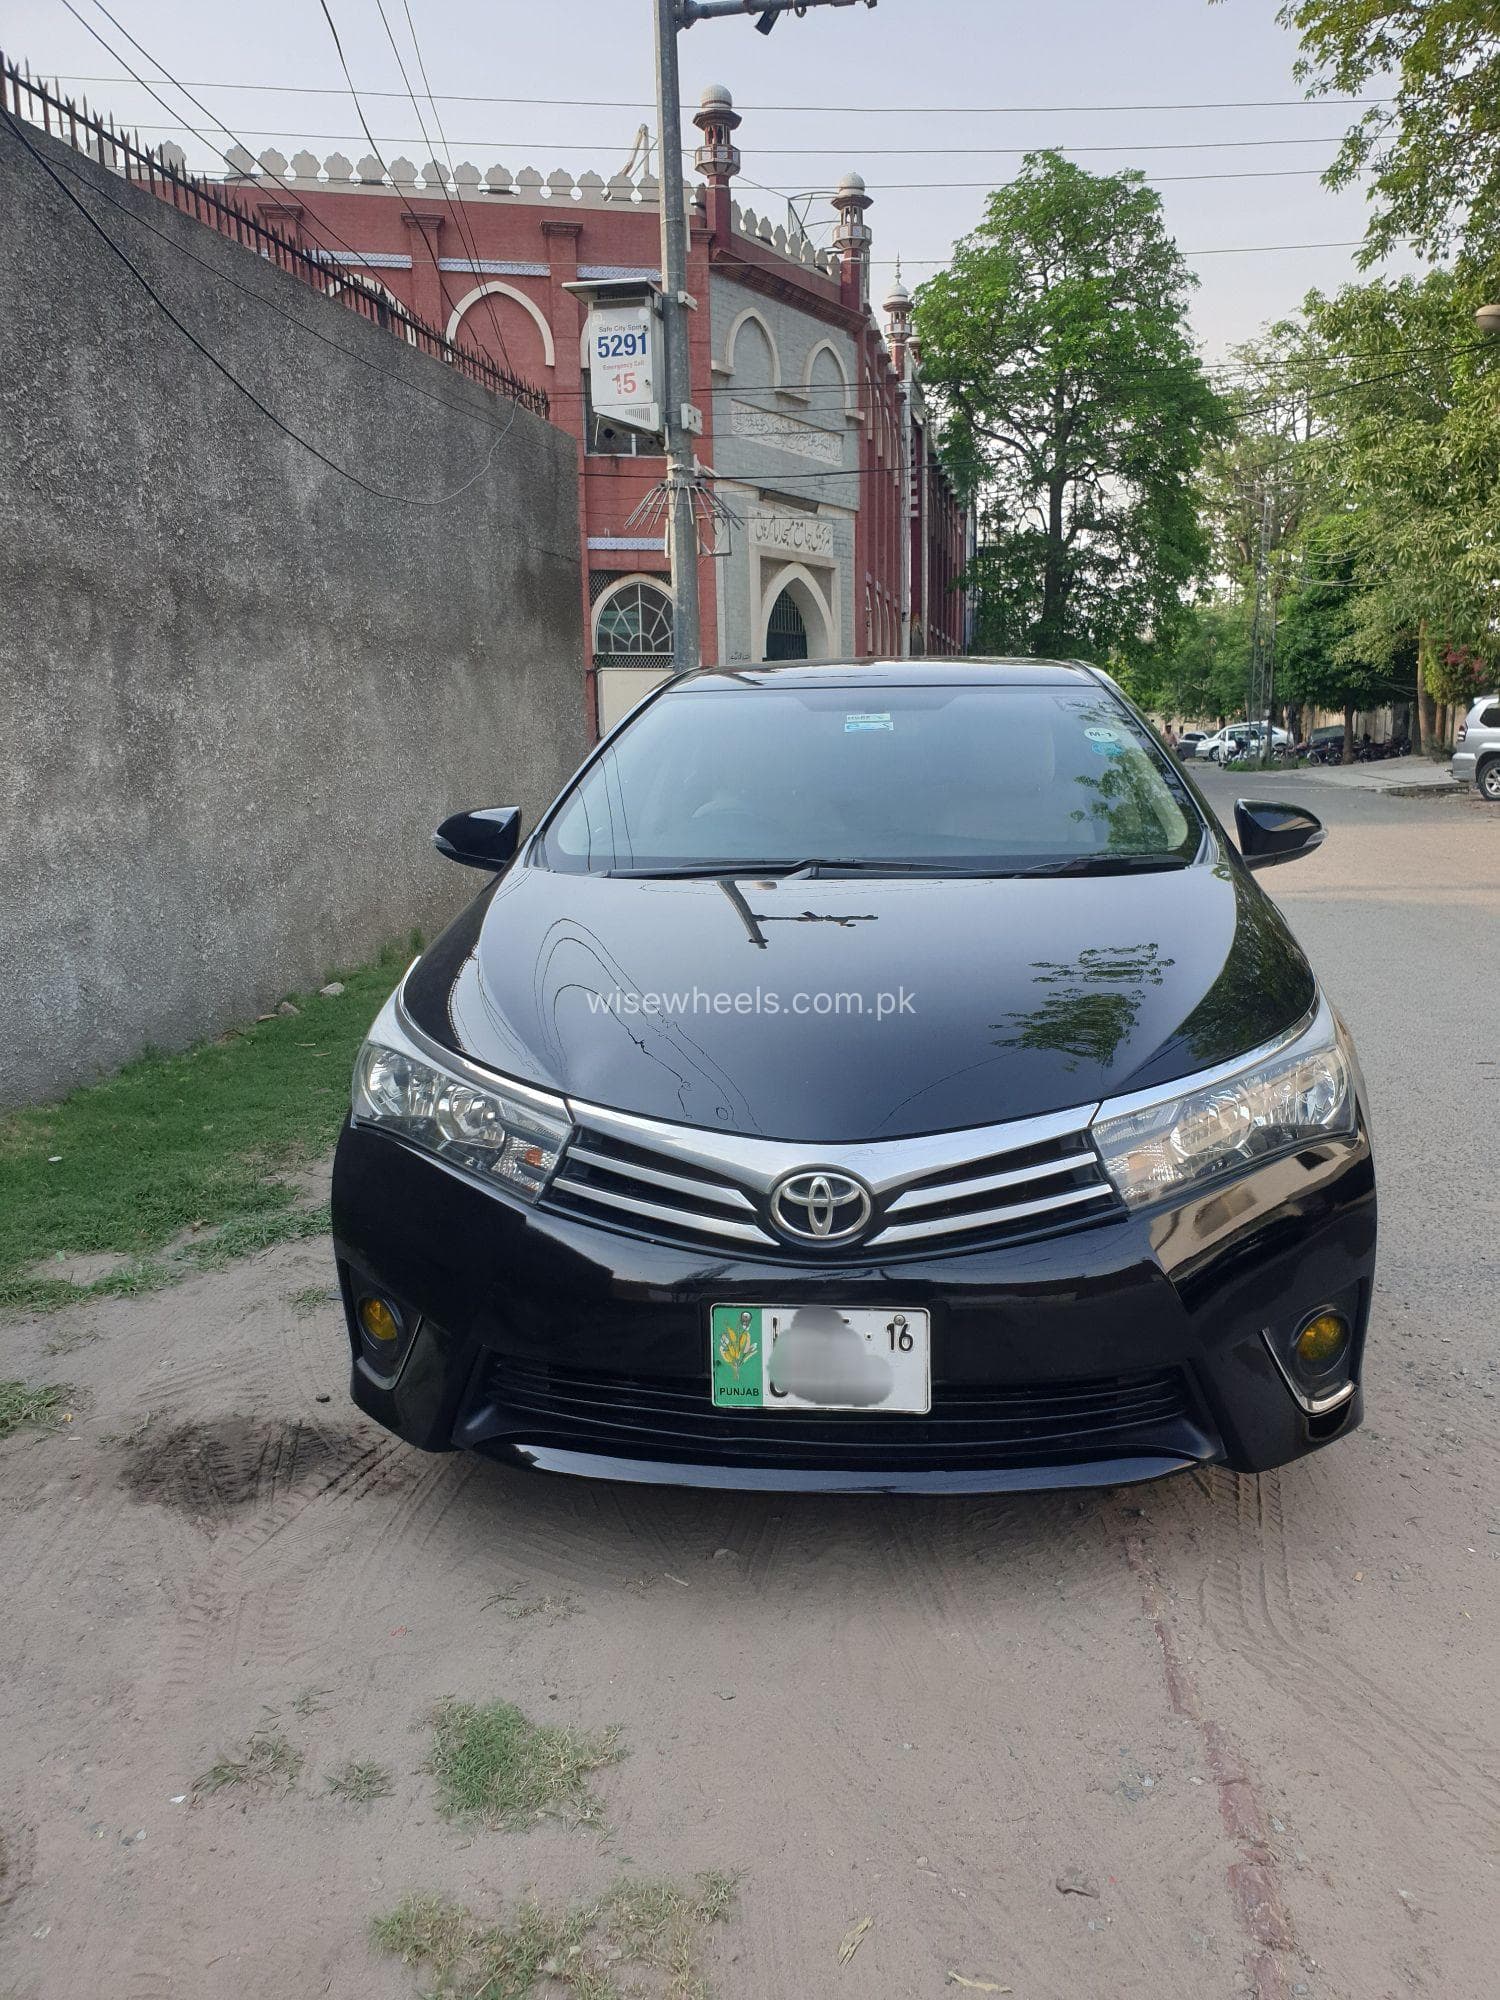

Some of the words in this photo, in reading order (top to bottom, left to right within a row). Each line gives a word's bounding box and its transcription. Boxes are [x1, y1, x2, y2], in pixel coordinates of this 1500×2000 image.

[597, 333, 647, 358] 5291
[612, 372, 637, 394] 15
[887, 1323, 914, 1351] 16
[719, 1387, 760, 1397] PUNJAB
